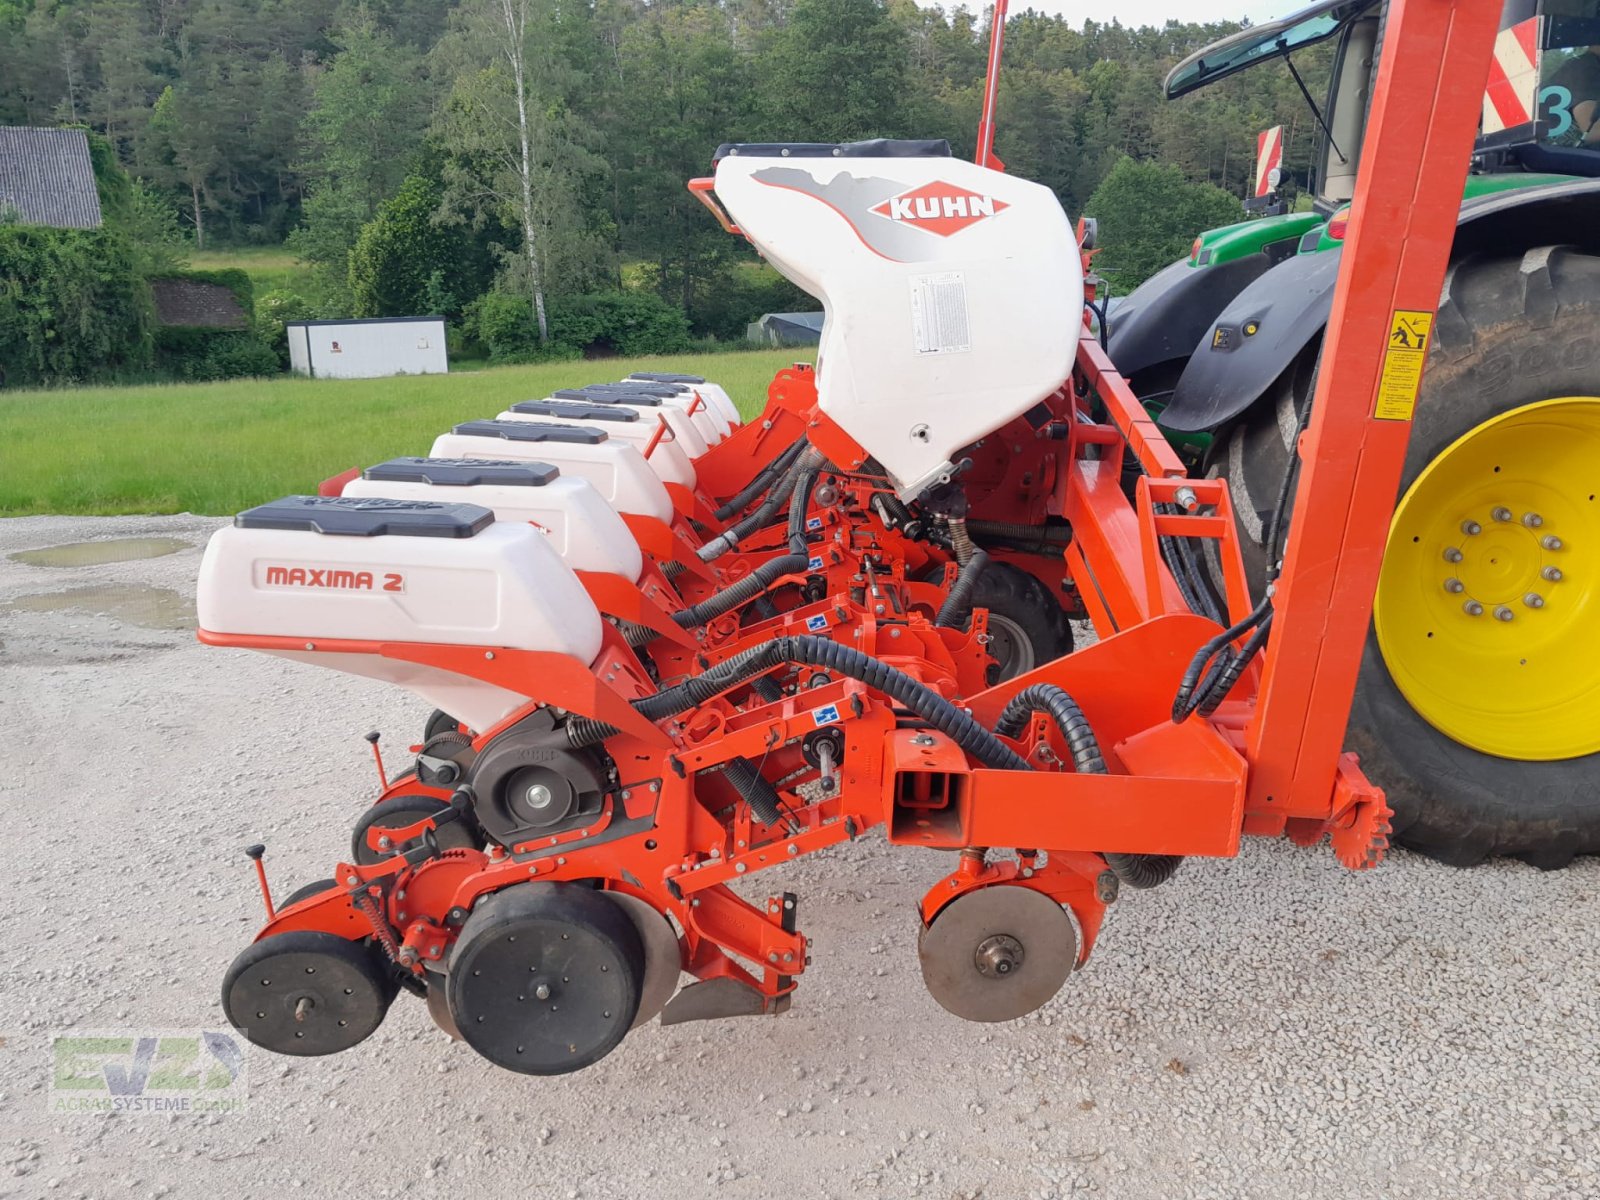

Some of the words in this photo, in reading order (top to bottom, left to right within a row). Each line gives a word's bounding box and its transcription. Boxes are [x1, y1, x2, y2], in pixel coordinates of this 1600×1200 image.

[1538, 85, 1572, 137] 3
[889, 195, 996, 221] KUHN
[266, 566, 374, 590] MAXIMA
[382, 573, 404, 592] 2
